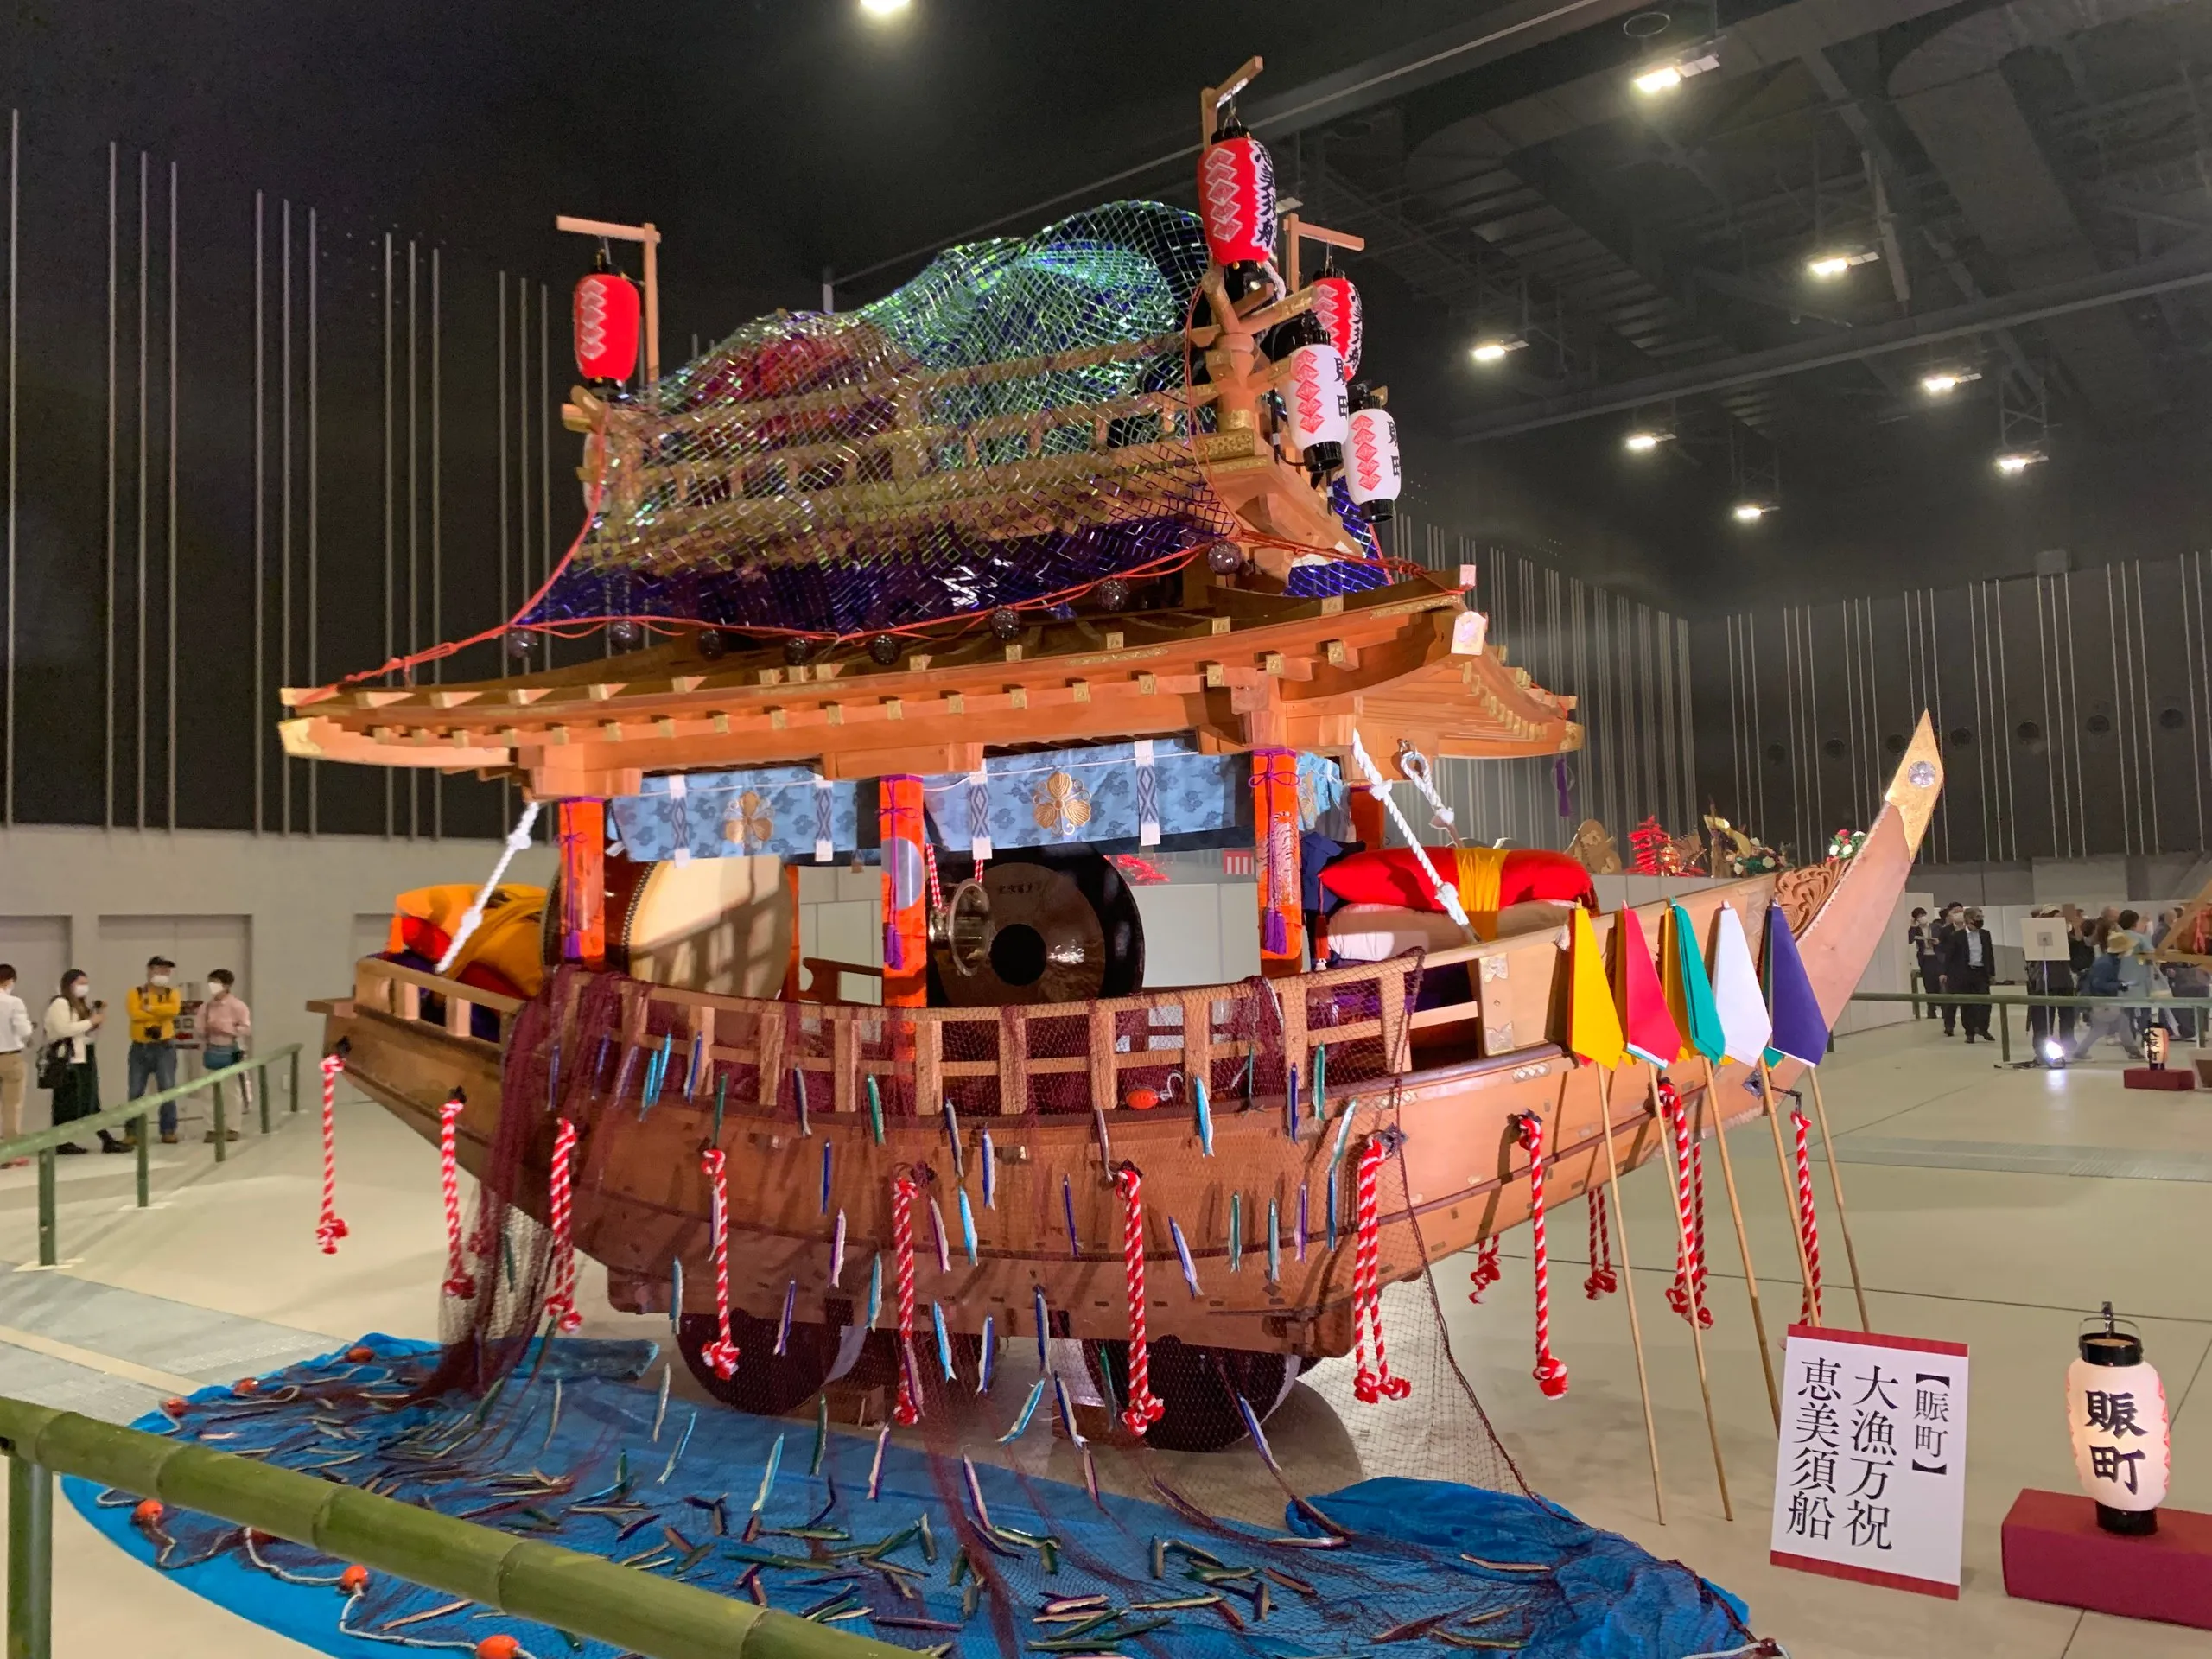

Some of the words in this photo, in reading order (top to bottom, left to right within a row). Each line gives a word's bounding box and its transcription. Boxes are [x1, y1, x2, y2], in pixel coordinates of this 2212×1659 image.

[1785, 1357, 1842, 1541] 恵美須船
[1842, 1364, 1900, 1550] 大漁万祝
[2084, 1389, 2148, 1496] 賑町
